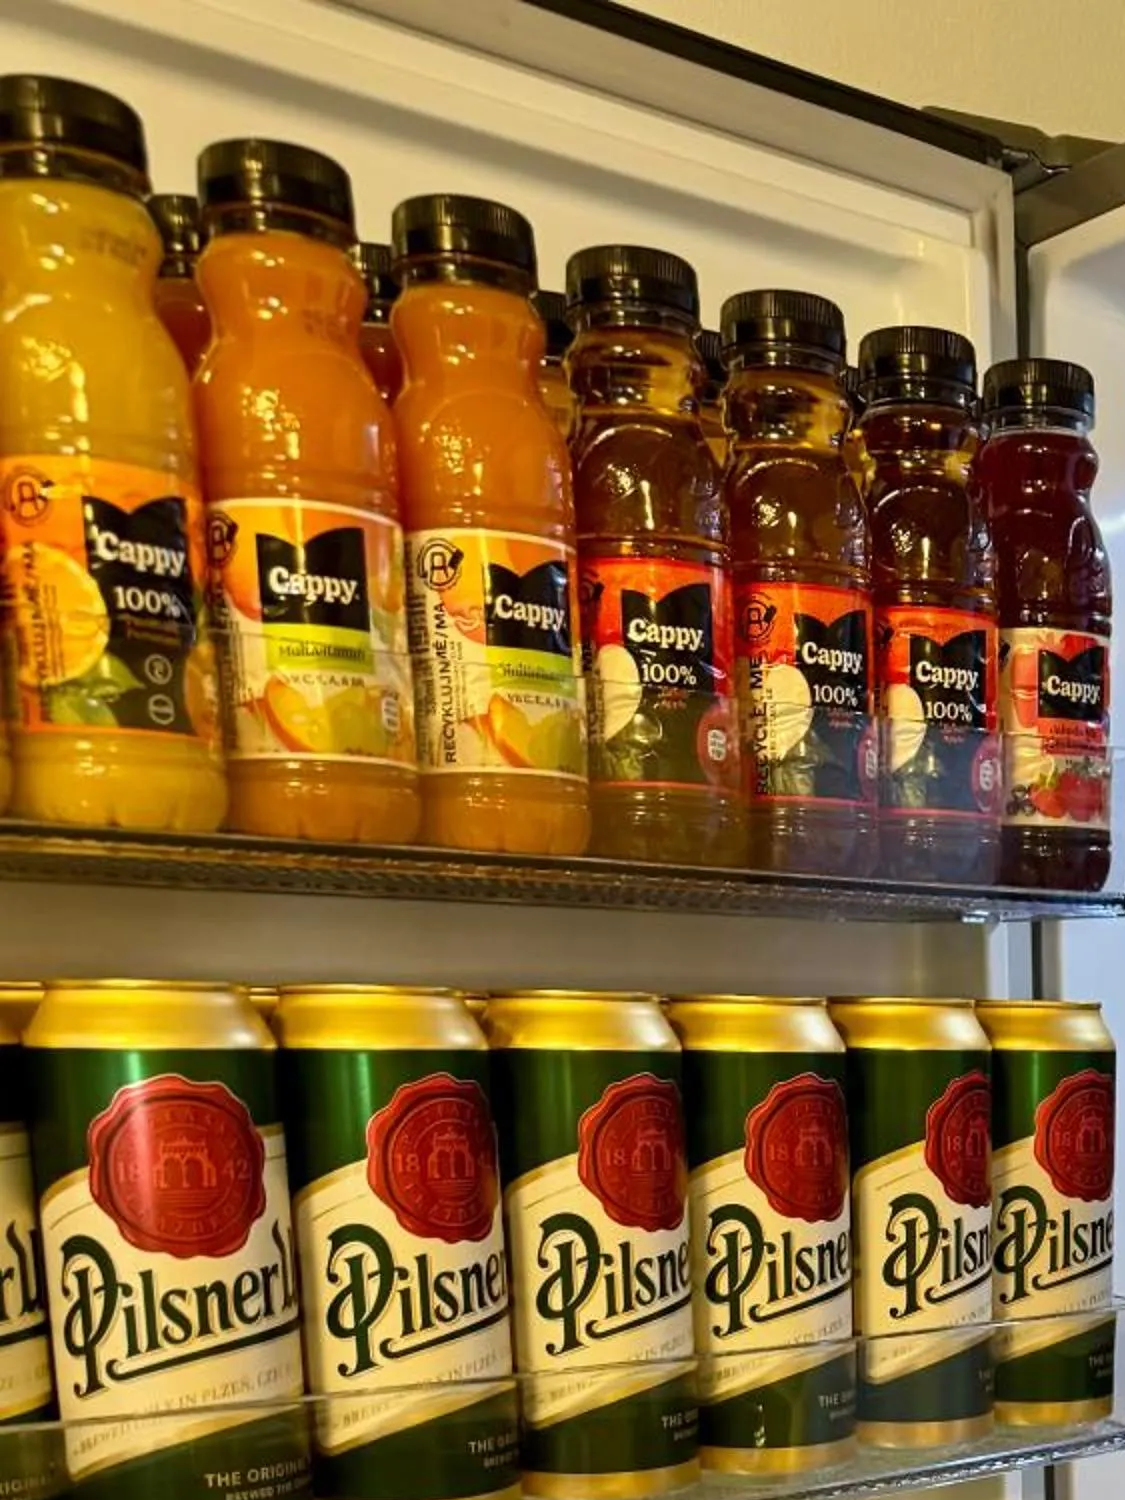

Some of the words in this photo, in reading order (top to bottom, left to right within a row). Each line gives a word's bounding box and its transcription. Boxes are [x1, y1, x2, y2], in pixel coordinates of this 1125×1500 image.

[97, 529, 187, 576] Cappy
[114, 584, 182, 618] 100%
[268, 566, 359, 605] Cappy
[495, 594, 566, 632] Cappy
[627, 617, 704, 650] Cappy
[641, 662, 697, 686] 100%
[801, 641, 862, 674] Cappy
[915, 660, 978, 692] Cappy
[1046, 674, 1101, 706] Cappy
[812, 683, 858, 708] 100%
[926, 701, 973, 723] 100%
[882, 1192, 991, 1320] Pilsn
[993, 1185, 1113, 1306] Pilsne
[536, 1211, 690, 1357] Pilsne
[705, 1203, 851, 1339] Pilsne
[61, 1234, 282, 1400] Pilsner
[203, 1470, 242, 1490] THE
